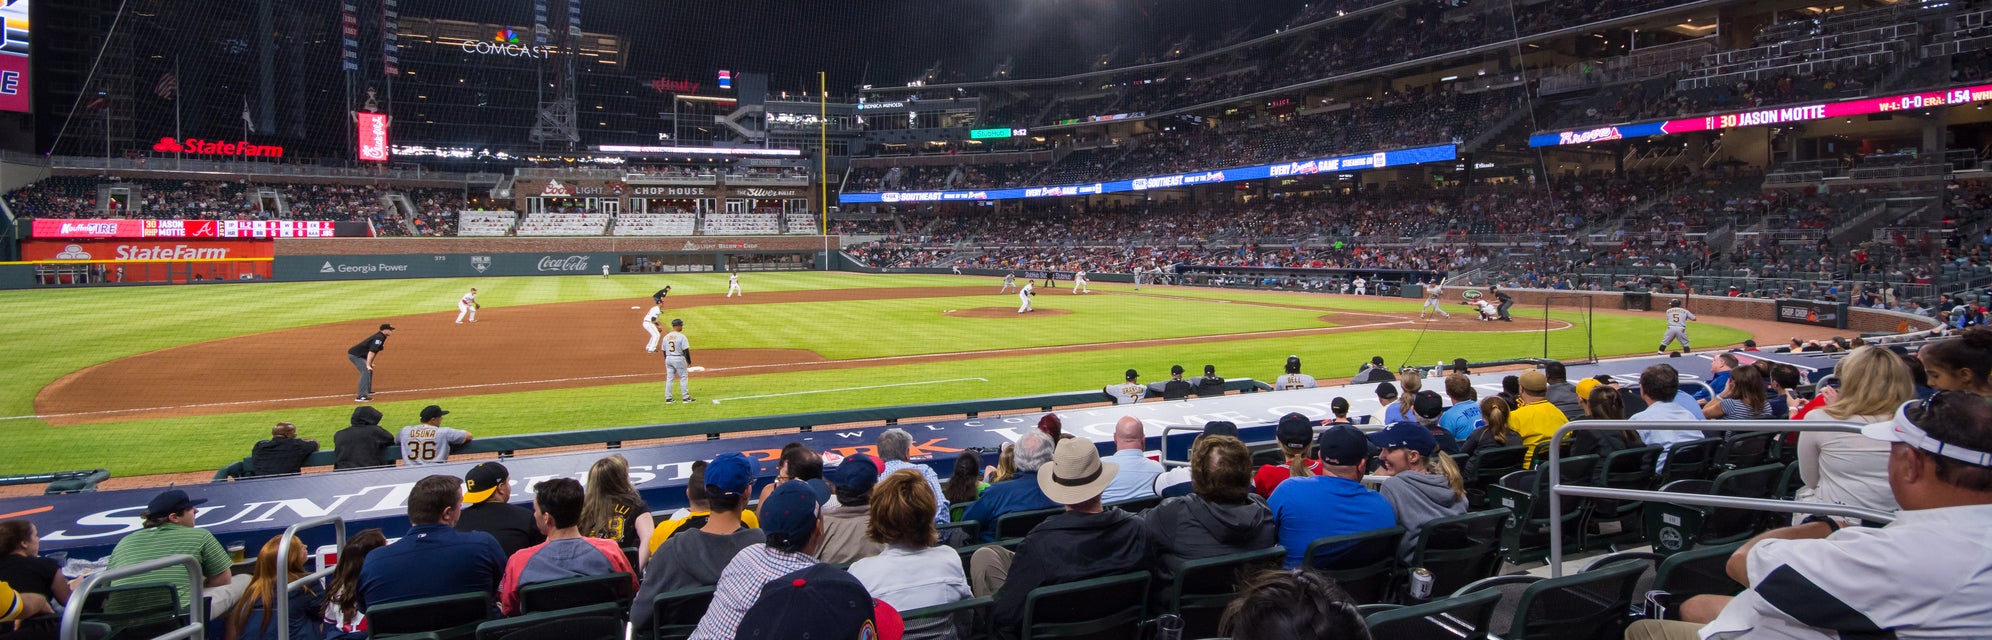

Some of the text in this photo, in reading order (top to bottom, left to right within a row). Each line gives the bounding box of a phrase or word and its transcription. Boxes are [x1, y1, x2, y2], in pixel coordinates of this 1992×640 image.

[462, 41, 548, 59] COMCAST
[1902, 96, 1921, 109] 0-0
[1923, 97, 1945, 107] ERA:
[1947, 90, 1970, 104] 1.54
[1720, 115, 1737, 128] 30
[1739, 109, 1778, 126] JASON
[1781, 104, 1825, 122] MOTTE
[1270, 164, 1291, 177] EVERY
[1318, 159, 1340, 172] GAME
[1148, 175, 1183, 188] SOUTHEAST
[575, 186, 603, 194] LIGHT
[635, 187, 705, 195] CHOP HOUSE
[746, 188, 777, 197] Silver
[1025, 188, 1042, 197] EVERY
[900, 192, 942, 201] SOUTHEAST
[145, 220, 184, 228] 30 JASON
[144, 228, 185, 237] RHP MOTTE
[338, 263, 408, 274] Georgia Power
[537, 255, 590, 272] Coca-Cola
[1672, 313, 1680, 323] 5
[668, 341, 676, 352] 3
[410, 429, 436, 438] OSUNA
[407, 440, 437, 461] 36
[467, 479, 476, 491] P
